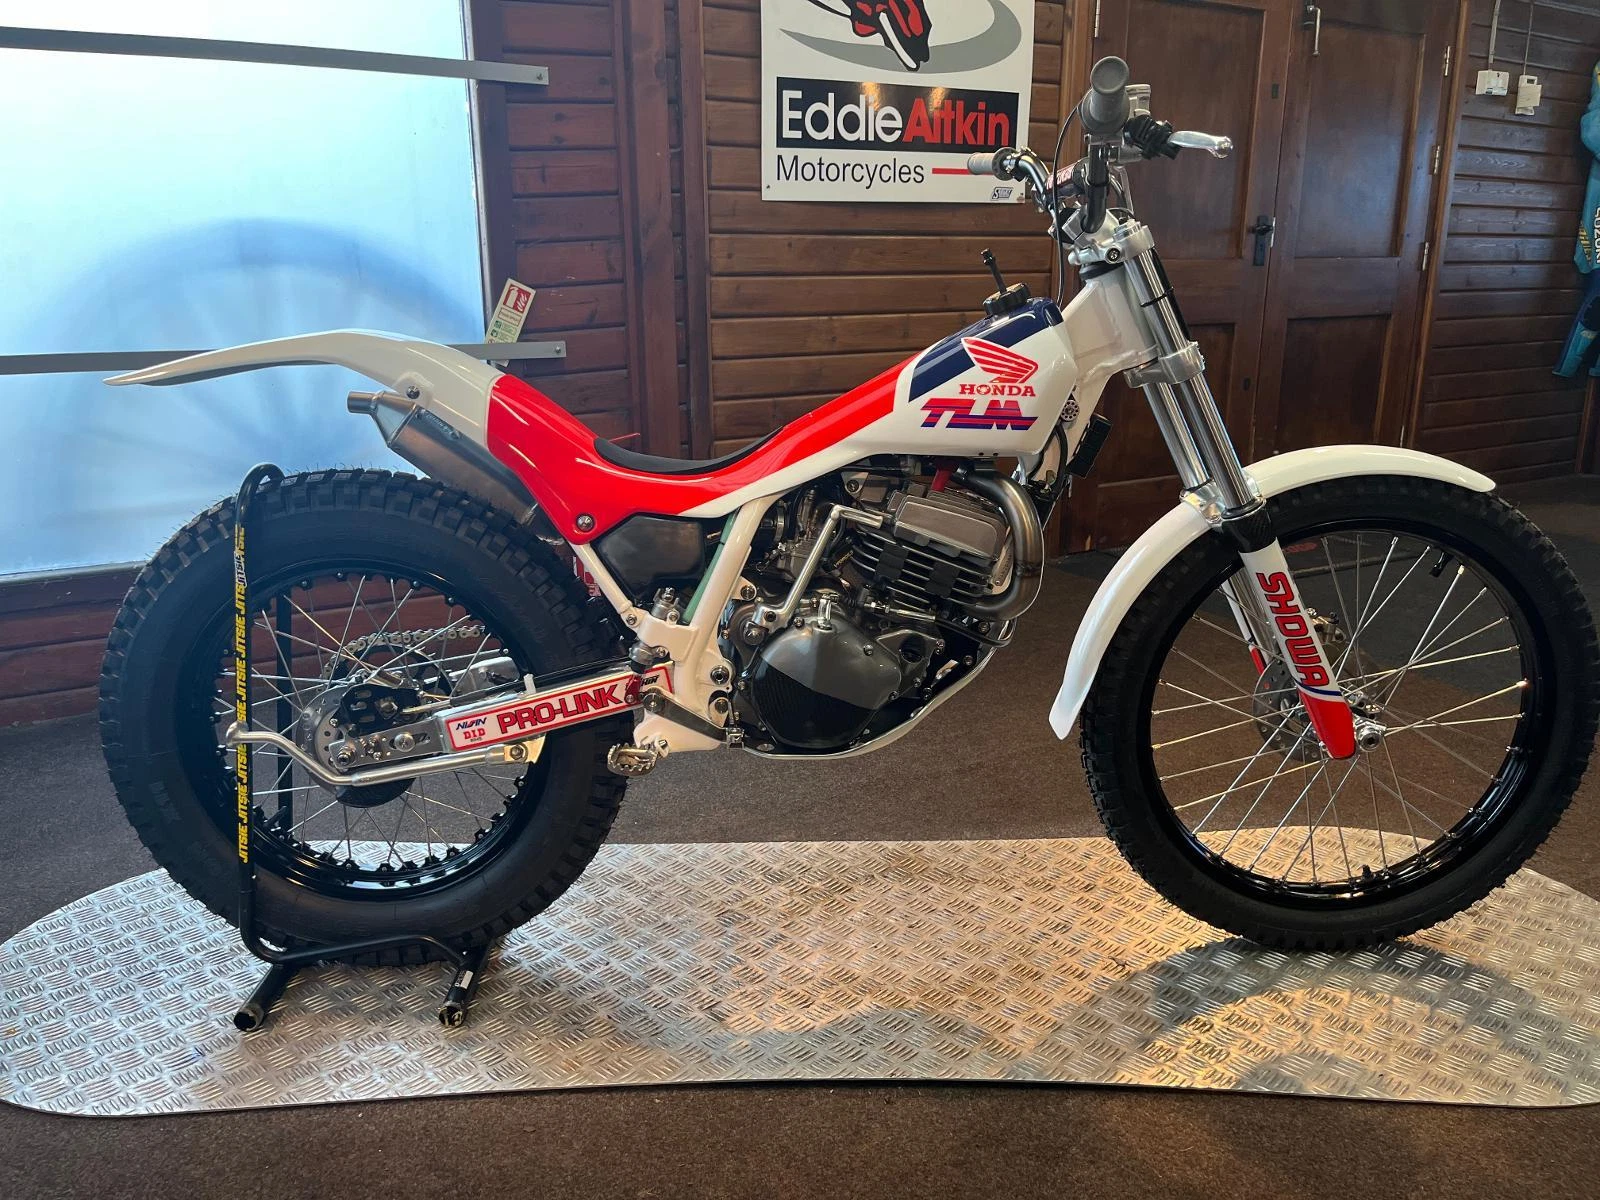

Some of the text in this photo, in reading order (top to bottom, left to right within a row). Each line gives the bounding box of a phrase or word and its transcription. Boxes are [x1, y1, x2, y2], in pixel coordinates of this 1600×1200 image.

[777, 154, 925, 189] Motorcycles
[959, 383, 1036, 397] HONDA
[920, 398, 1039, 430] TLM
[235, 614, 247, 658] JITSIE
[1256, 571, 1329, 686] SHOWA
[236, 658, 247, 701] JITSIE
[496, 684, 623, 734] PRO-LINK
[238, 822, 249, 864] JITSIE
